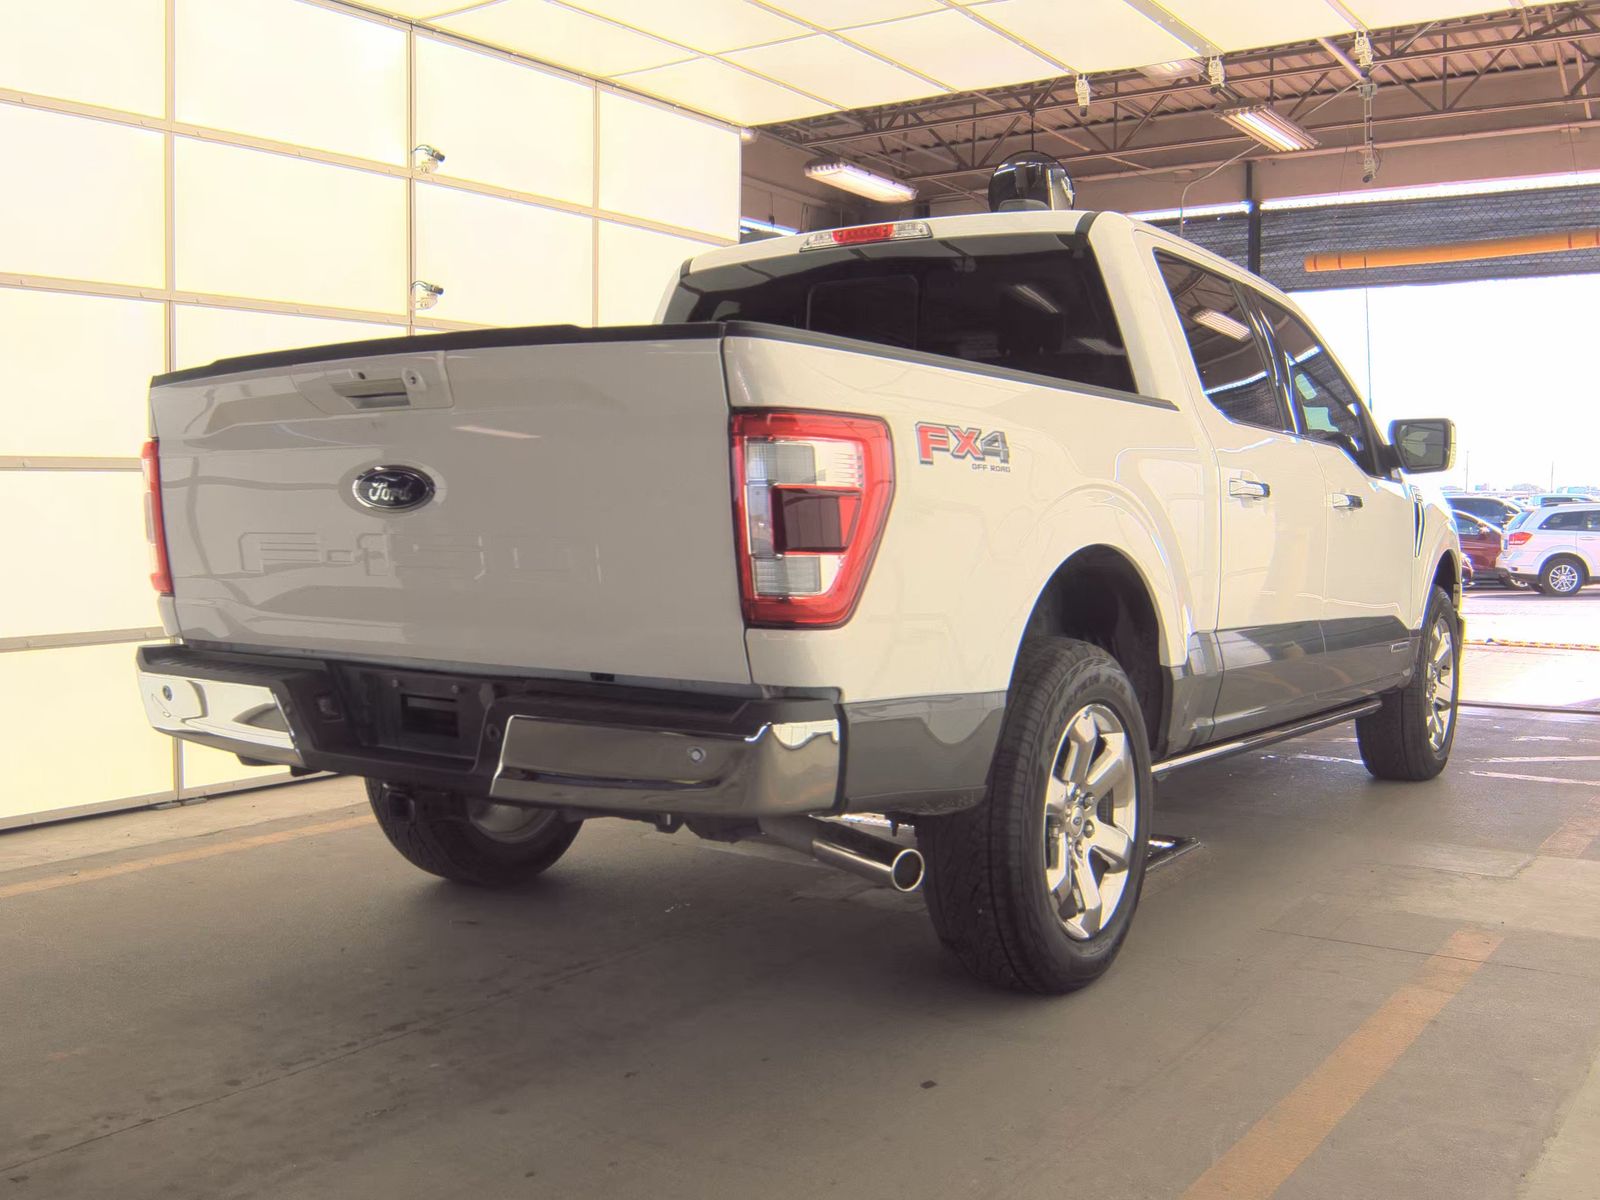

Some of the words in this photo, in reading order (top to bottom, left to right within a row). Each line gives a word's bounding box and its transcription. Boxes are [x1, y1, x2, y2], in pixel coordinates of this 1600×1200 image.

[915, 421, 1010, 465] FX4
[971, 463, 989, 471] OFF
[990, 465, 1011, 473] ROAD
[367, 481, 414, 501] Ford
